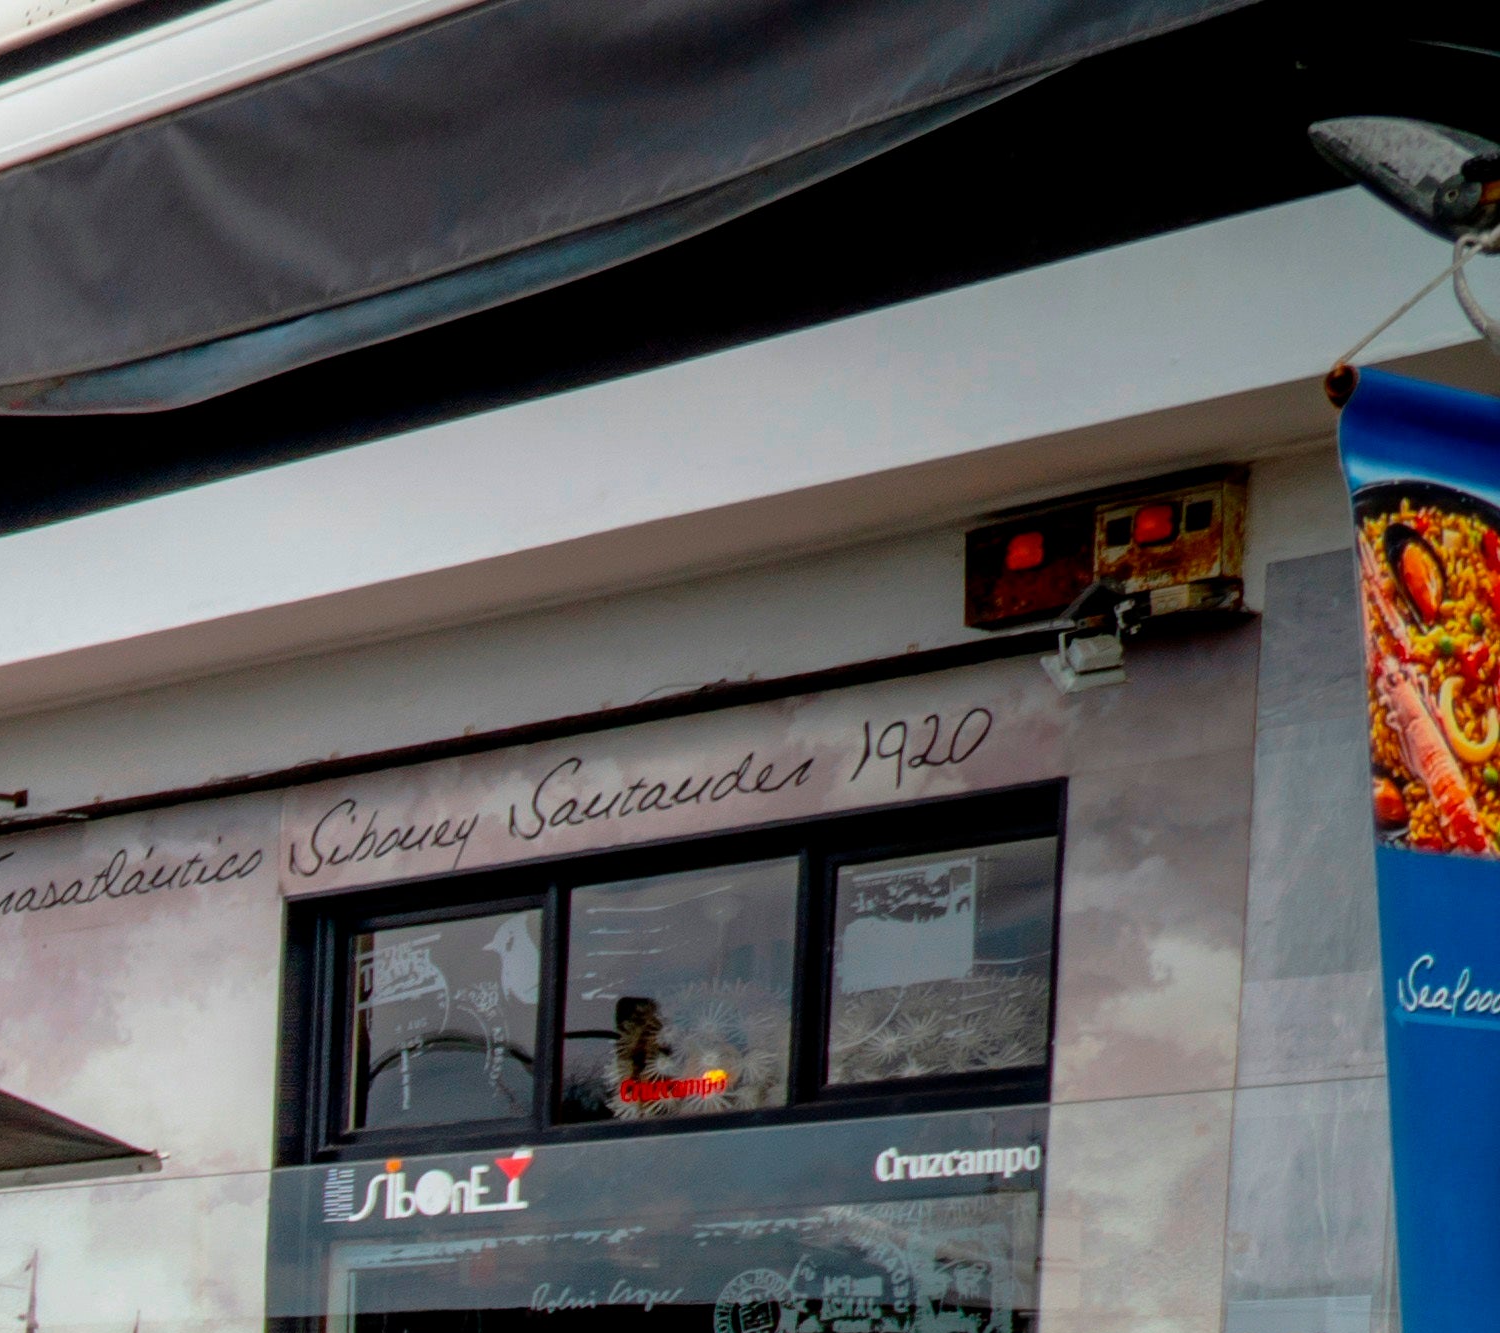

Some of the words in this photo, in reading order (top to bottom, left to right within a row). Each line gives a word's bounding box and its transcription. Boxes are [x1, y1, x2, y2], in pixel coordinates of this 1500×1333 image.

[289, 798, 479, 877] Siboney
[850, 707, 993, 790] 1920
[874, 1146, 1042, 1182] Cruzcampo
